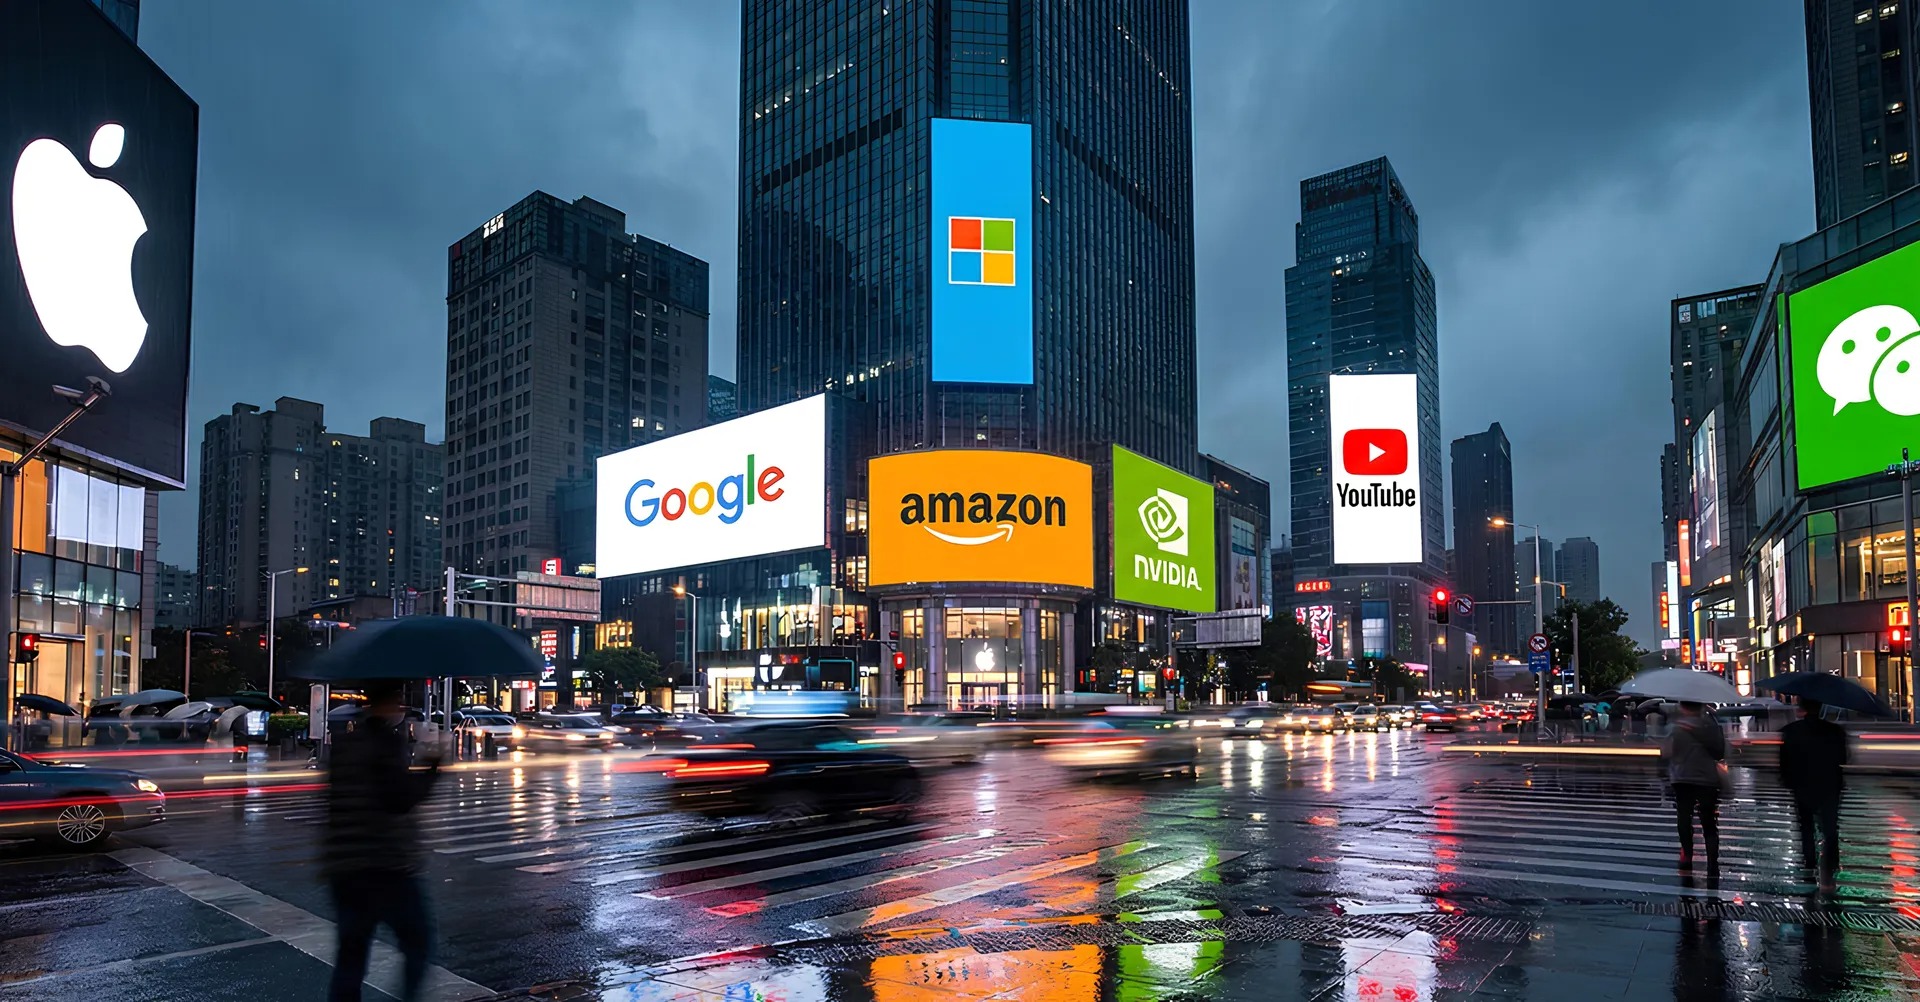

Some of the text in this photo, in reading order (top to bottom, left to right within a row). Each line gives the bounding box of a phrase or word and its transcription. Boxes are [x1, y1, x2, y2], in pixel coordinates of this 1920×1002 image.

[625, 454, 785, 527] Google
[1337, 481, 1416, 508] YouTube
[900, 491, 1066, 527] amazon
